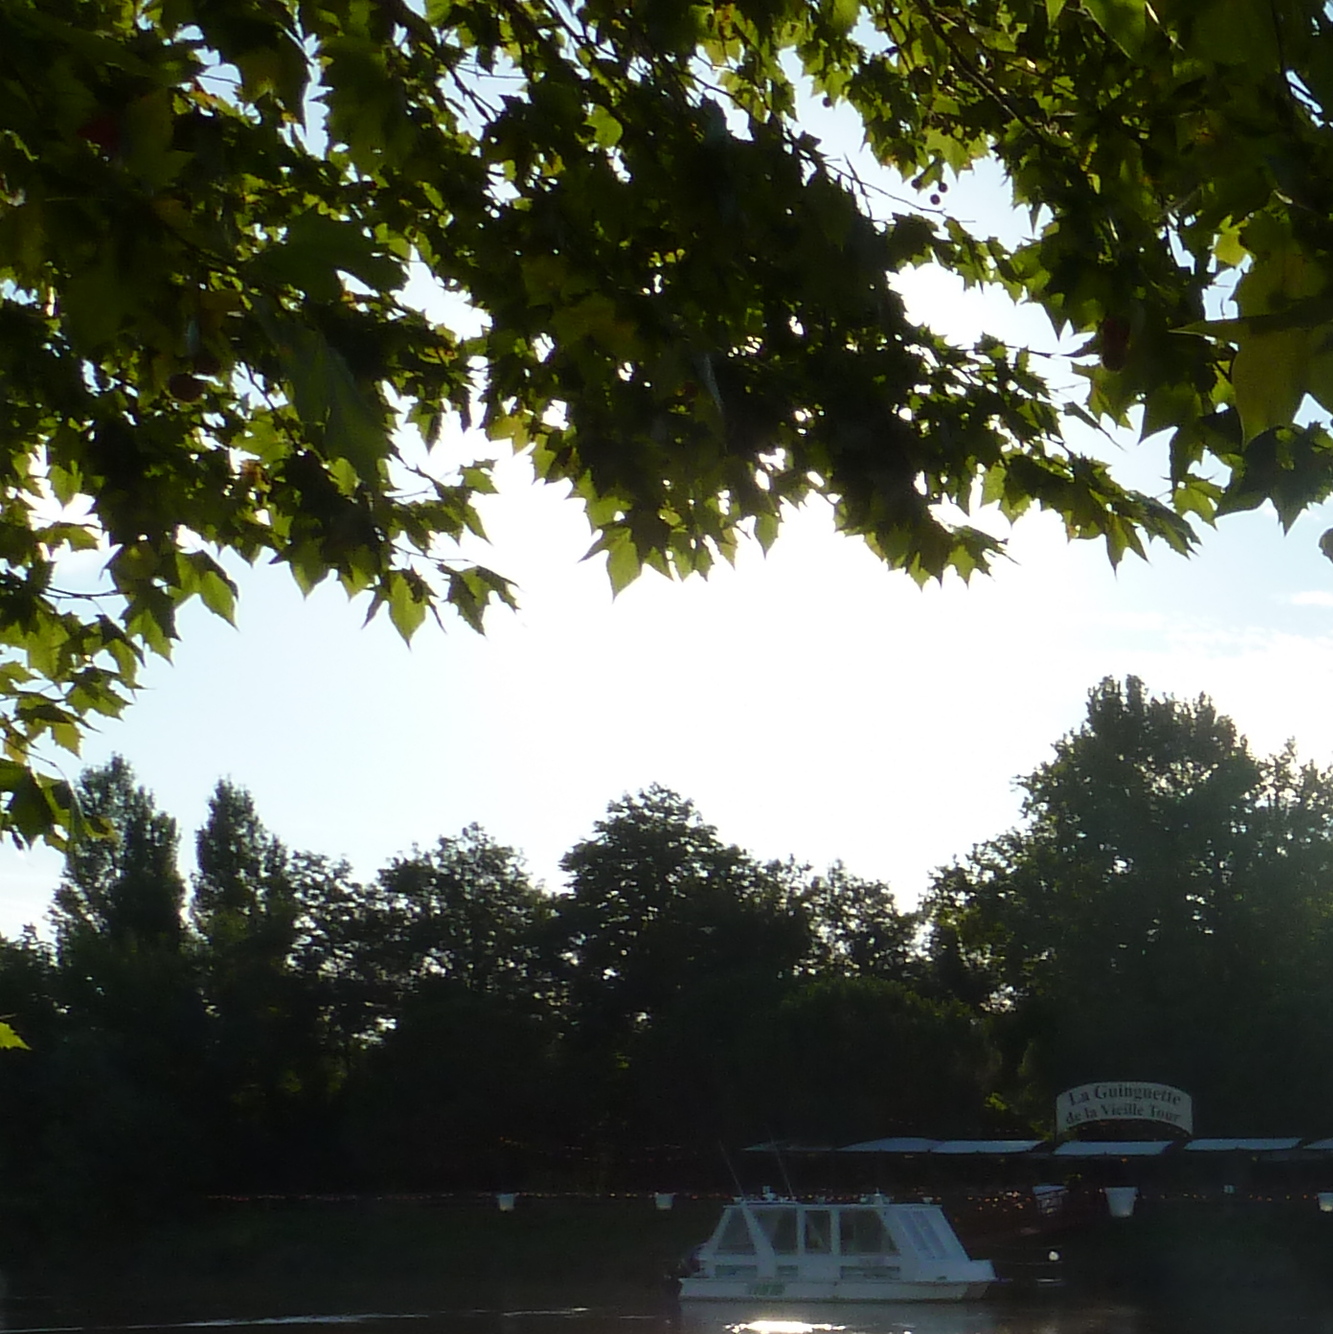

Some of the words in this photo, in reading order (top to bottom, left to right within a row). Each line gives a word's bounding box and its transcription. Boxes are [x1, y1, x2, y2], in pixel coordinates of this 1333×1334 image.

[1069, 1091, 1090, 1106] La
[1095, 1085, 1181, 1105] Guinguette
[1066, 1112, 1080, 1124] de
[1085, 1108, 1098, 1119] la
[1101, 1103, 1143, 1117] Vieille
[1150, 1105, 1181, 1123] Tour
